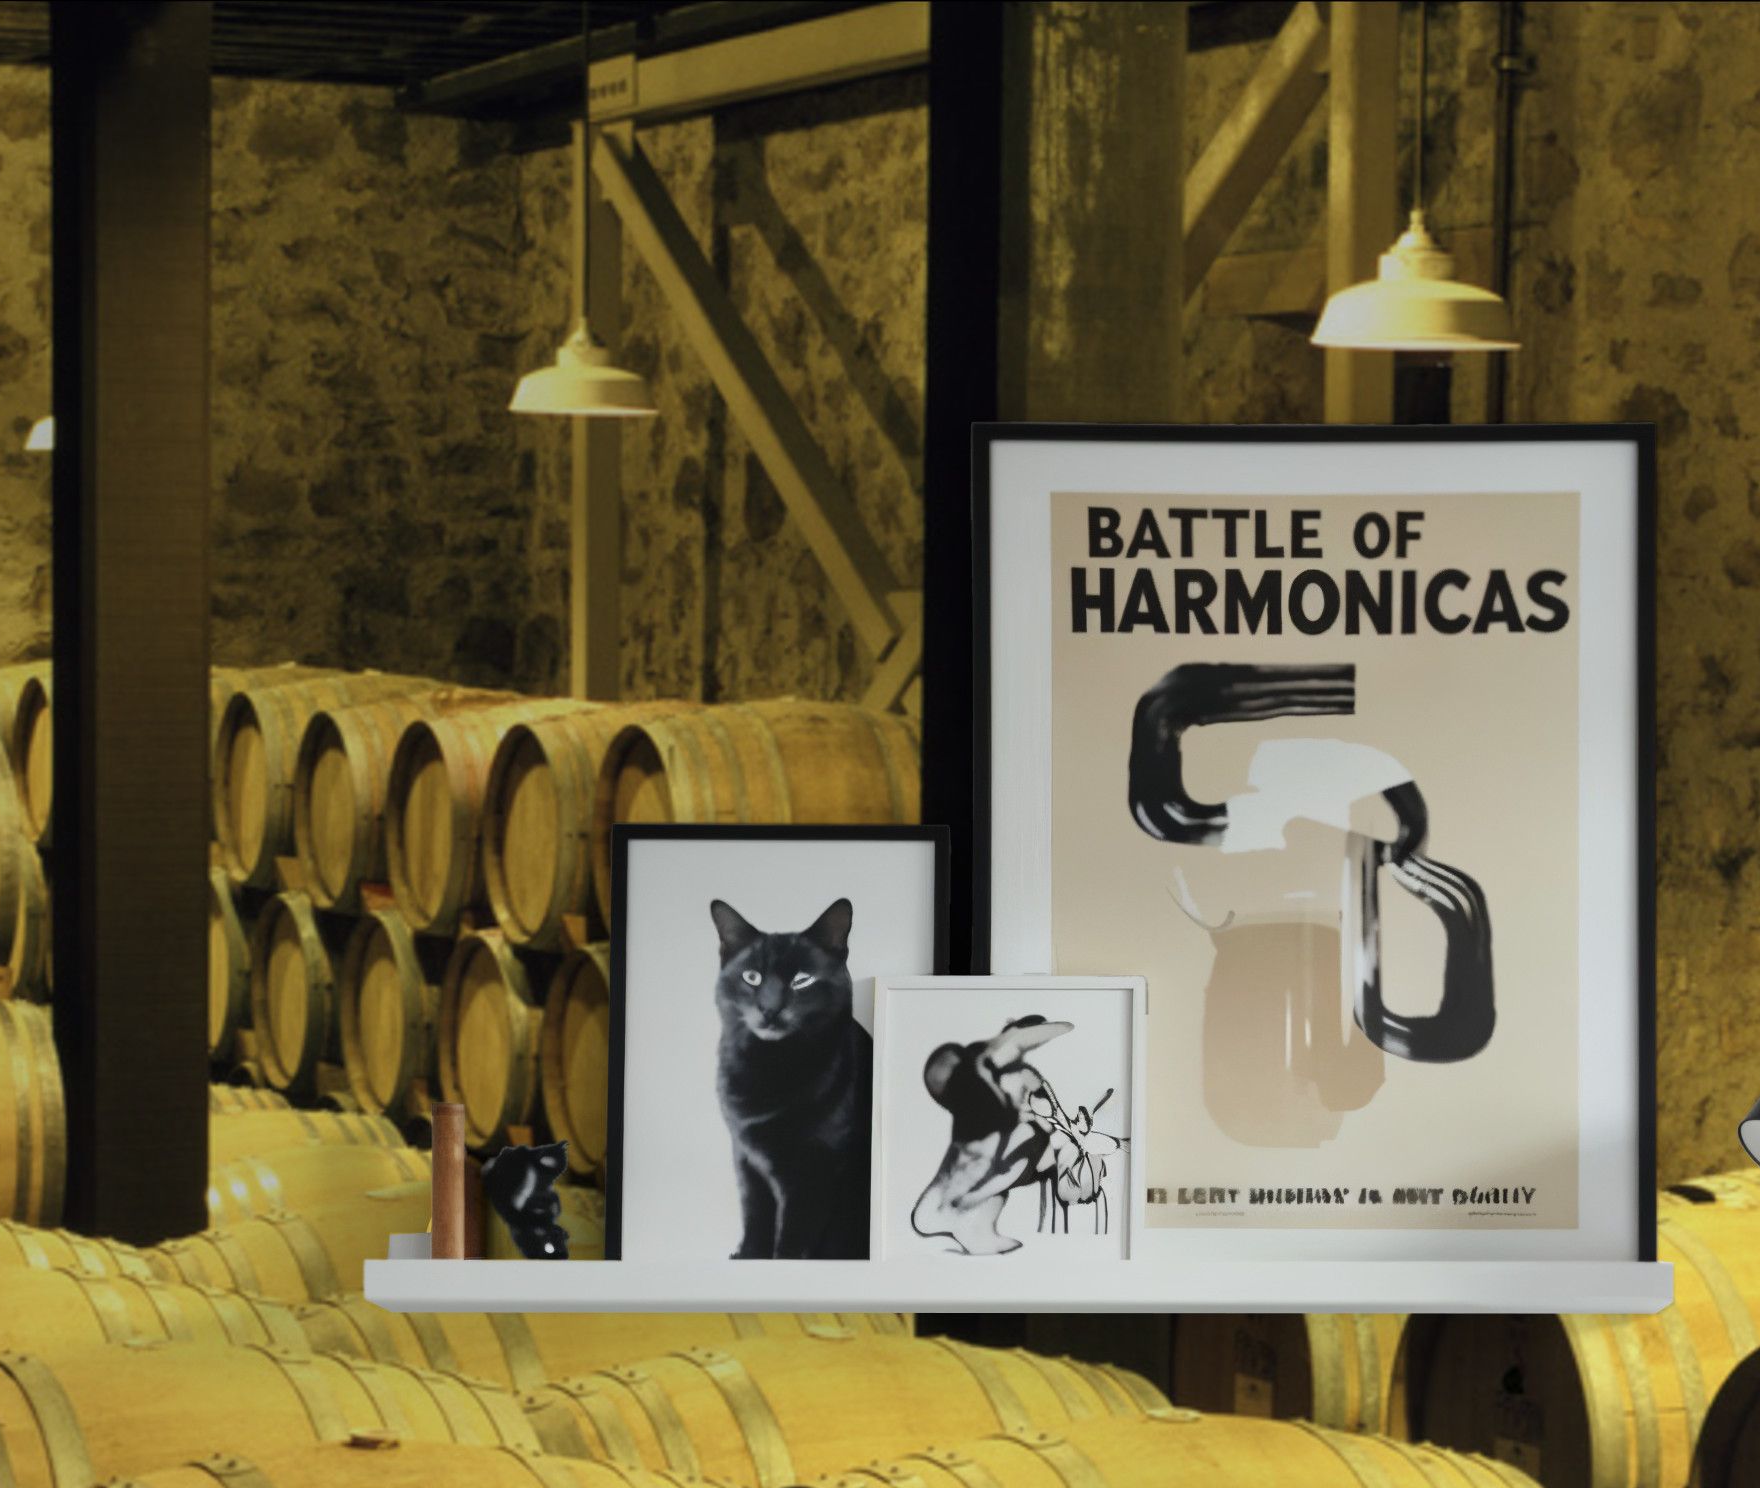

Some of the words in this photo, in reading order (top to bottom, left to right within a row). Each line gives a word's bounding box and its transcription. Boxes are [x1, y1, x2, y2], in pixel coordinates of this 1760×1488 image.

[1088, 507, 1322, 558] BATTLE
[1354, 512, 1424, 559] OF
[1071, 567, 1569, 635] HARMONICAS
